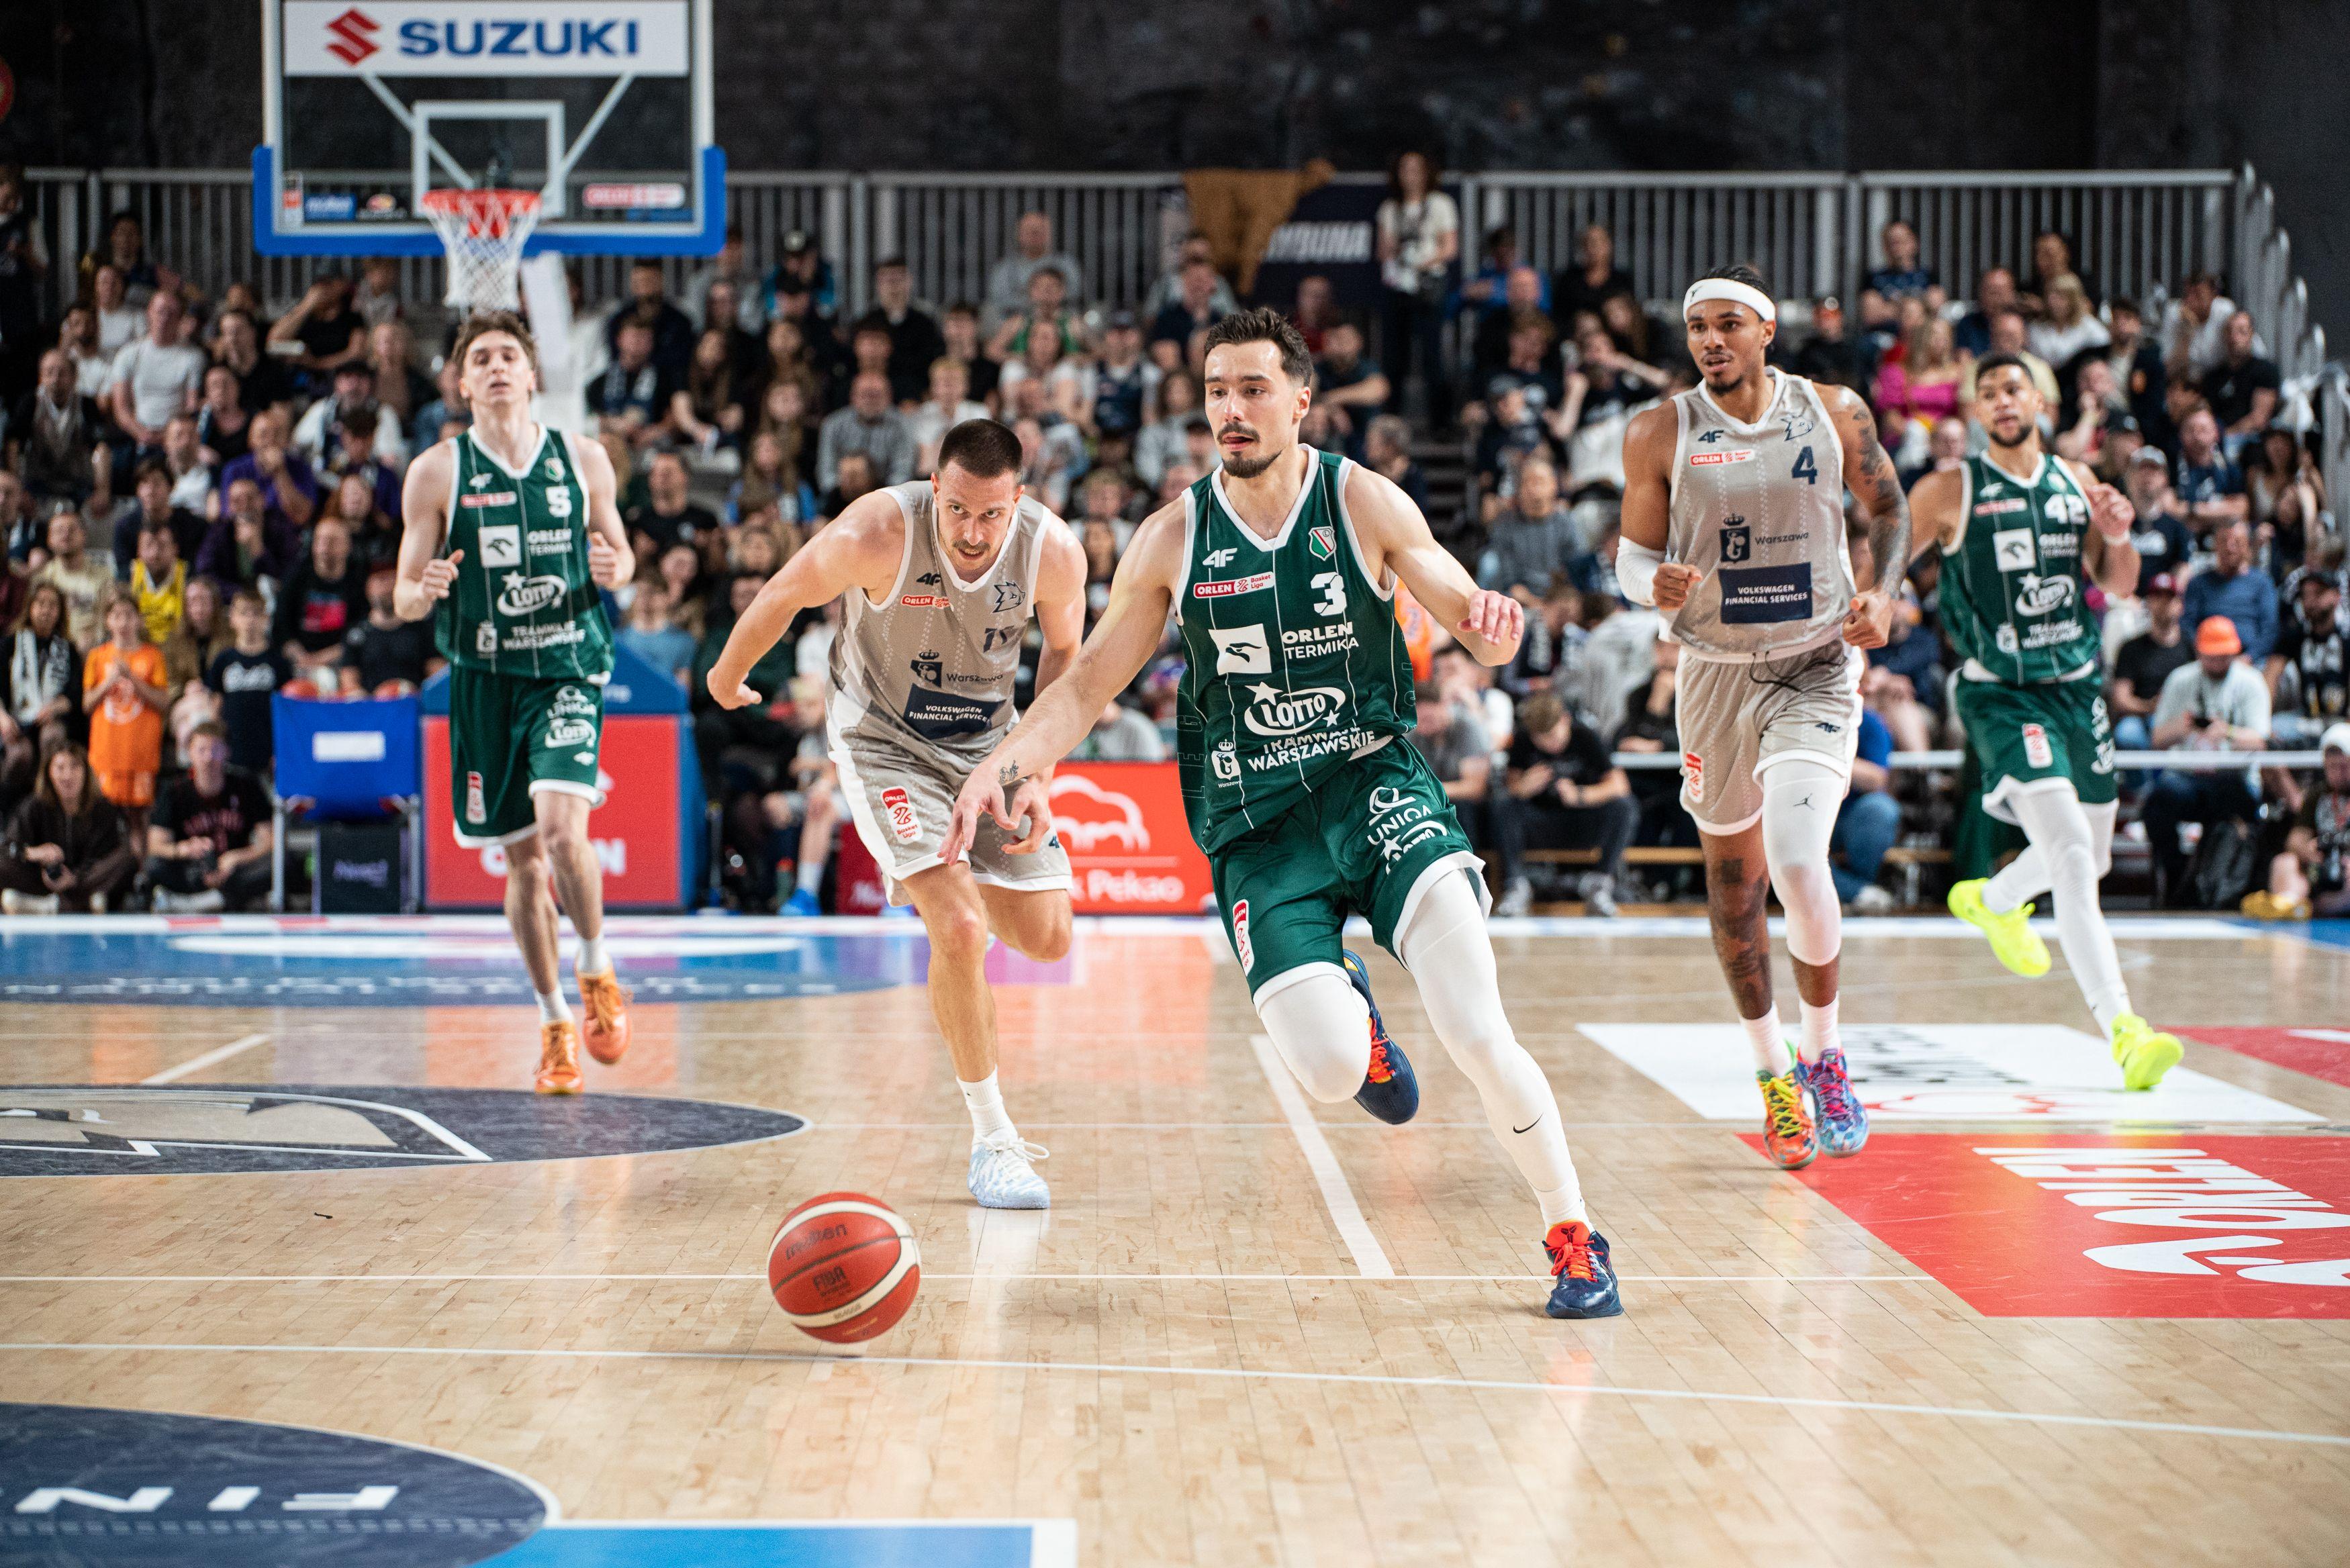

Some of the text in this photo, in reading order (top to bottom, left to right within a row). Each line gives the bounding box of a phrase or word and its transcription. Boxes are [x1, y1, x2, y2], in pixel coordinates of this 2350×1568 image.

[397, 19, 639, 56] SUZUKI
[1697, 430, 1724, 443] 4F
[1692, 456, 1721, 464] ORLEN
[1791, 446, 1818, 485] 4
[545, 486, 571, 517] 5
[1755, 532, 1809, 545] Warszawa
[1203, 548, 1237, 568] 4F
[1250, 575, 1270, 583] Basket
[1197, 584, 1232, 595] ORLEN
[1310, 571, 1347, 616] 3
[1725, 591, 1808, 605] FINANCIAL SERVICES
[1738, 584, 1795, 595] VOLKSWAGEN
[904, 597, 931, 605] ORLEN
[1281, 622, 1354, 644] ORLEN
[1284, 637, 1359, 660] TERMIKA
[909, 711, 953, 722] FINANCIAL
[926, 705, 982, 714] VOLKSWAGEN
[1260, 694, 1327, 728] LOTTO
[1248, 730, 1375, 772] WARSZAWSKIE
[897, 824, 918, 834] Basket
[1367, 805, 1432, 846] UNIQA
[1087, 869, 1184, 902] Pekao
[1973, 1147, 2350, 1230] ORLEN
